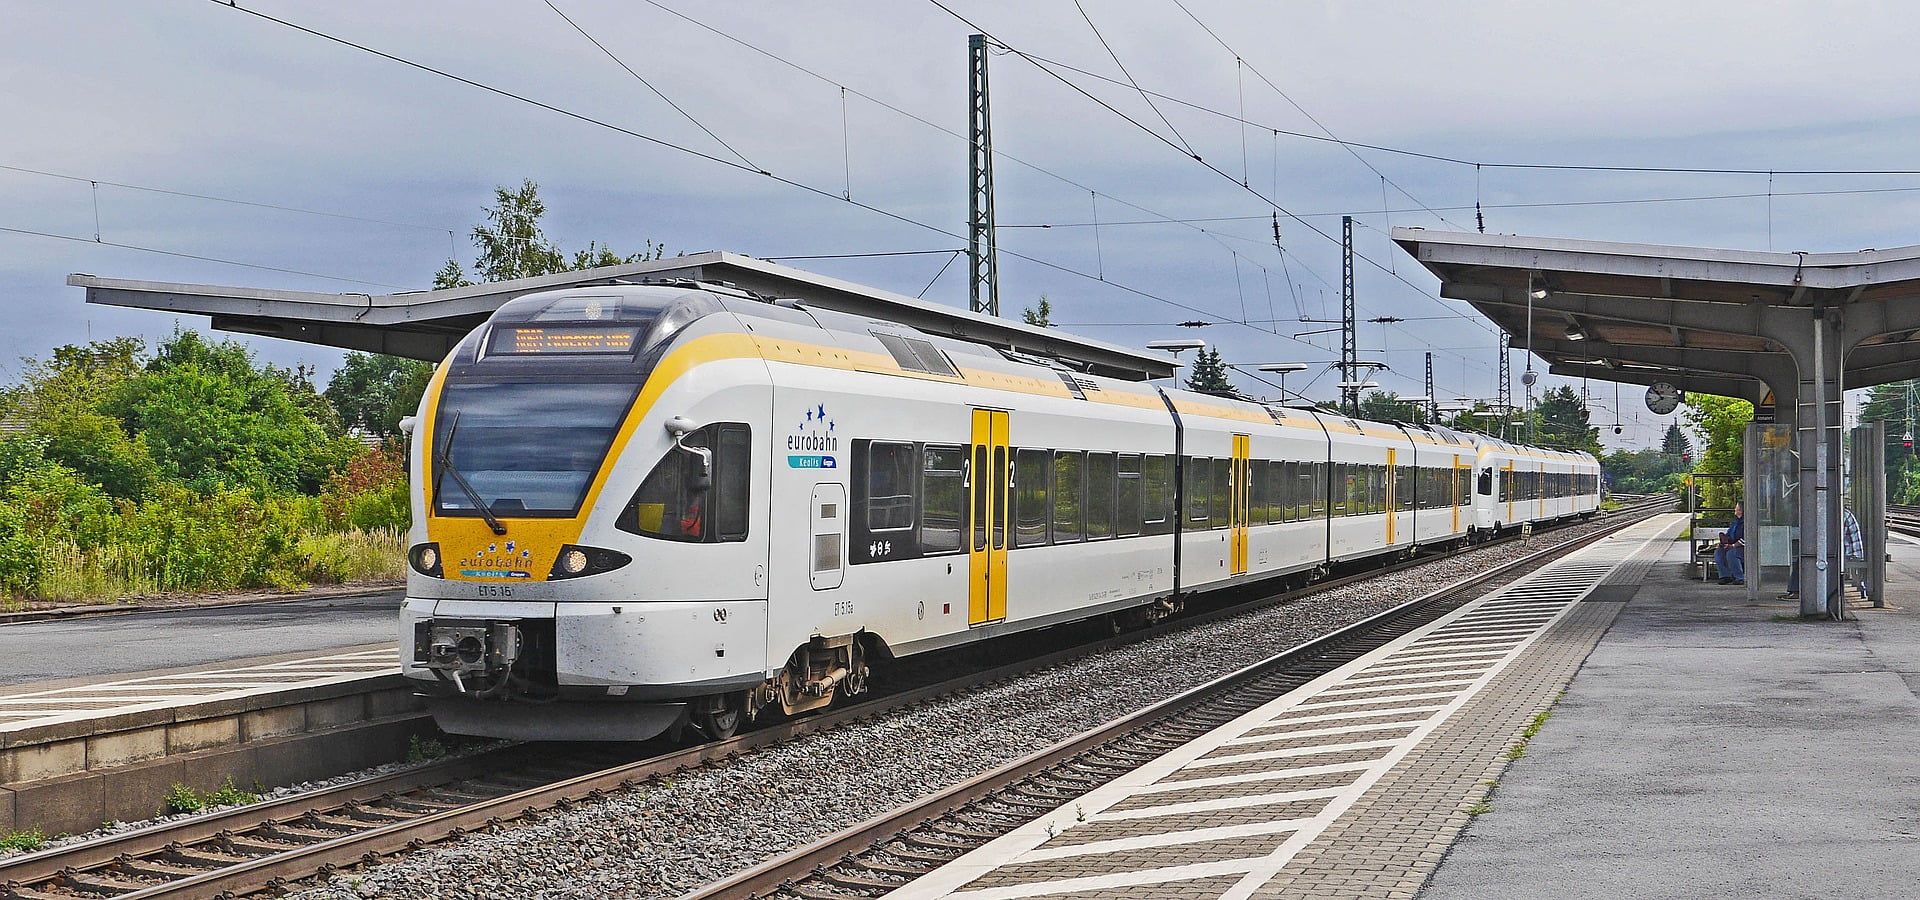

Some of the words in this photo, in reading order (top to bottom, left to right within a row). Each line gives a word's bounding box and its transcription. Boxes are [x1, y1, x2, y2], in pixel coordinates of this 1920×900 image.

[787, 430, 838, 451] eurobahn
[963, 458, 970, 488] 2
[1009, 460, 1016, 488] 2
[460, 556, 533, 568] eurobahn
[479, 585, 488, 597] ET
[490, 585, 512, 597] 5.15
